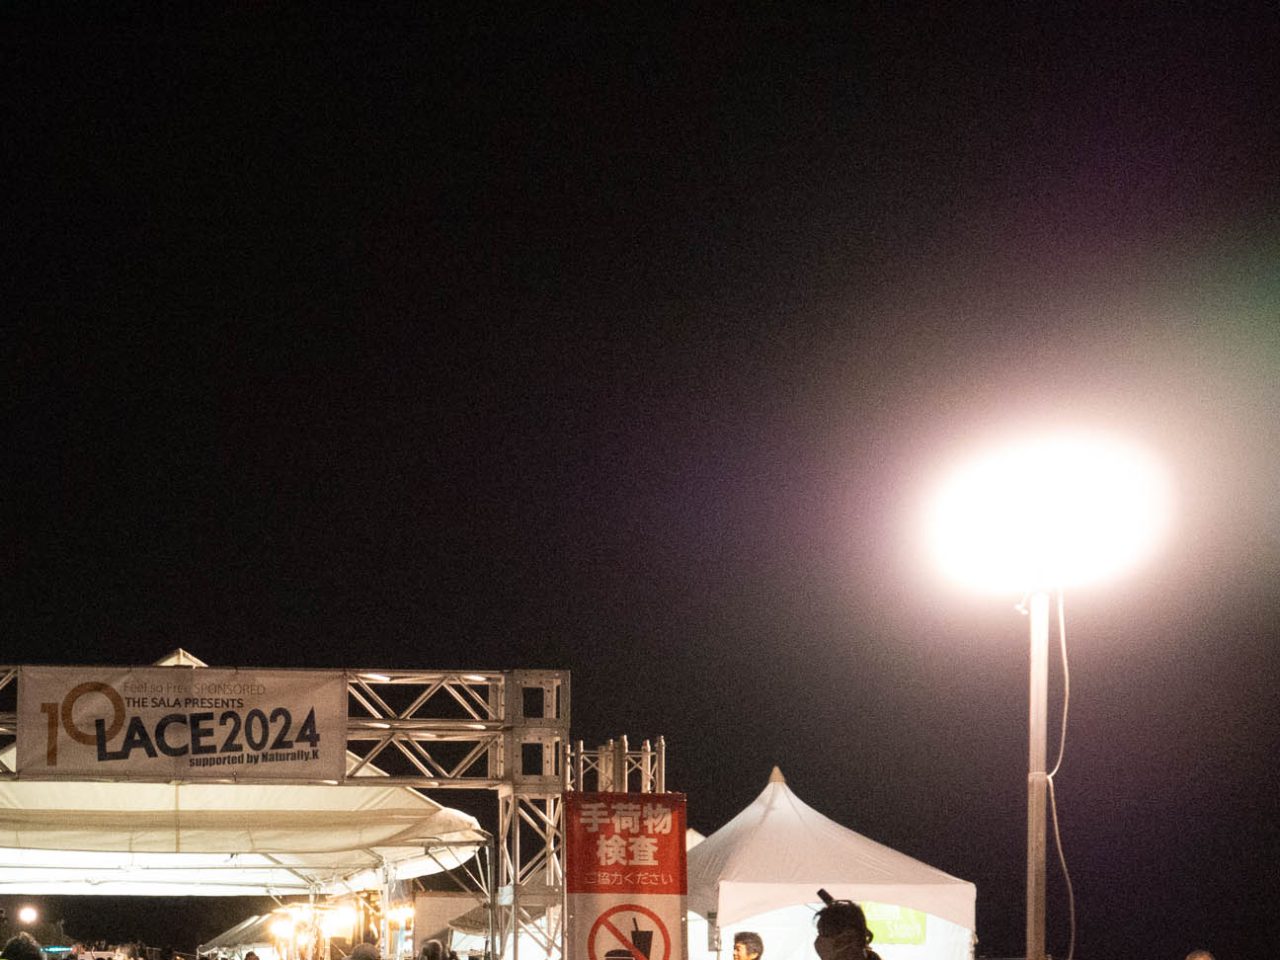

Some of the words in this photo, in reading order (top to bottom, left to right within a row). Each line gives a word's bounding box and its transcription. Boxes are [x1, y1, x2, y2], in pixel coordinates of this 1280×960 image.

[193, 682, 266, 696] SPONSORED
[125, 697, 149, 708] THE
[151, 697, 182, 708] SALA
[185, 697, 244, 709] PRESENTS
[189, 753, 244, 767] supported
[247, 753, 259, 764] by
[580, 802, 672, 835] 手荷物
[596, 834, 659, 866] 検査
[584, 871, 673, 886] ご協力ください
